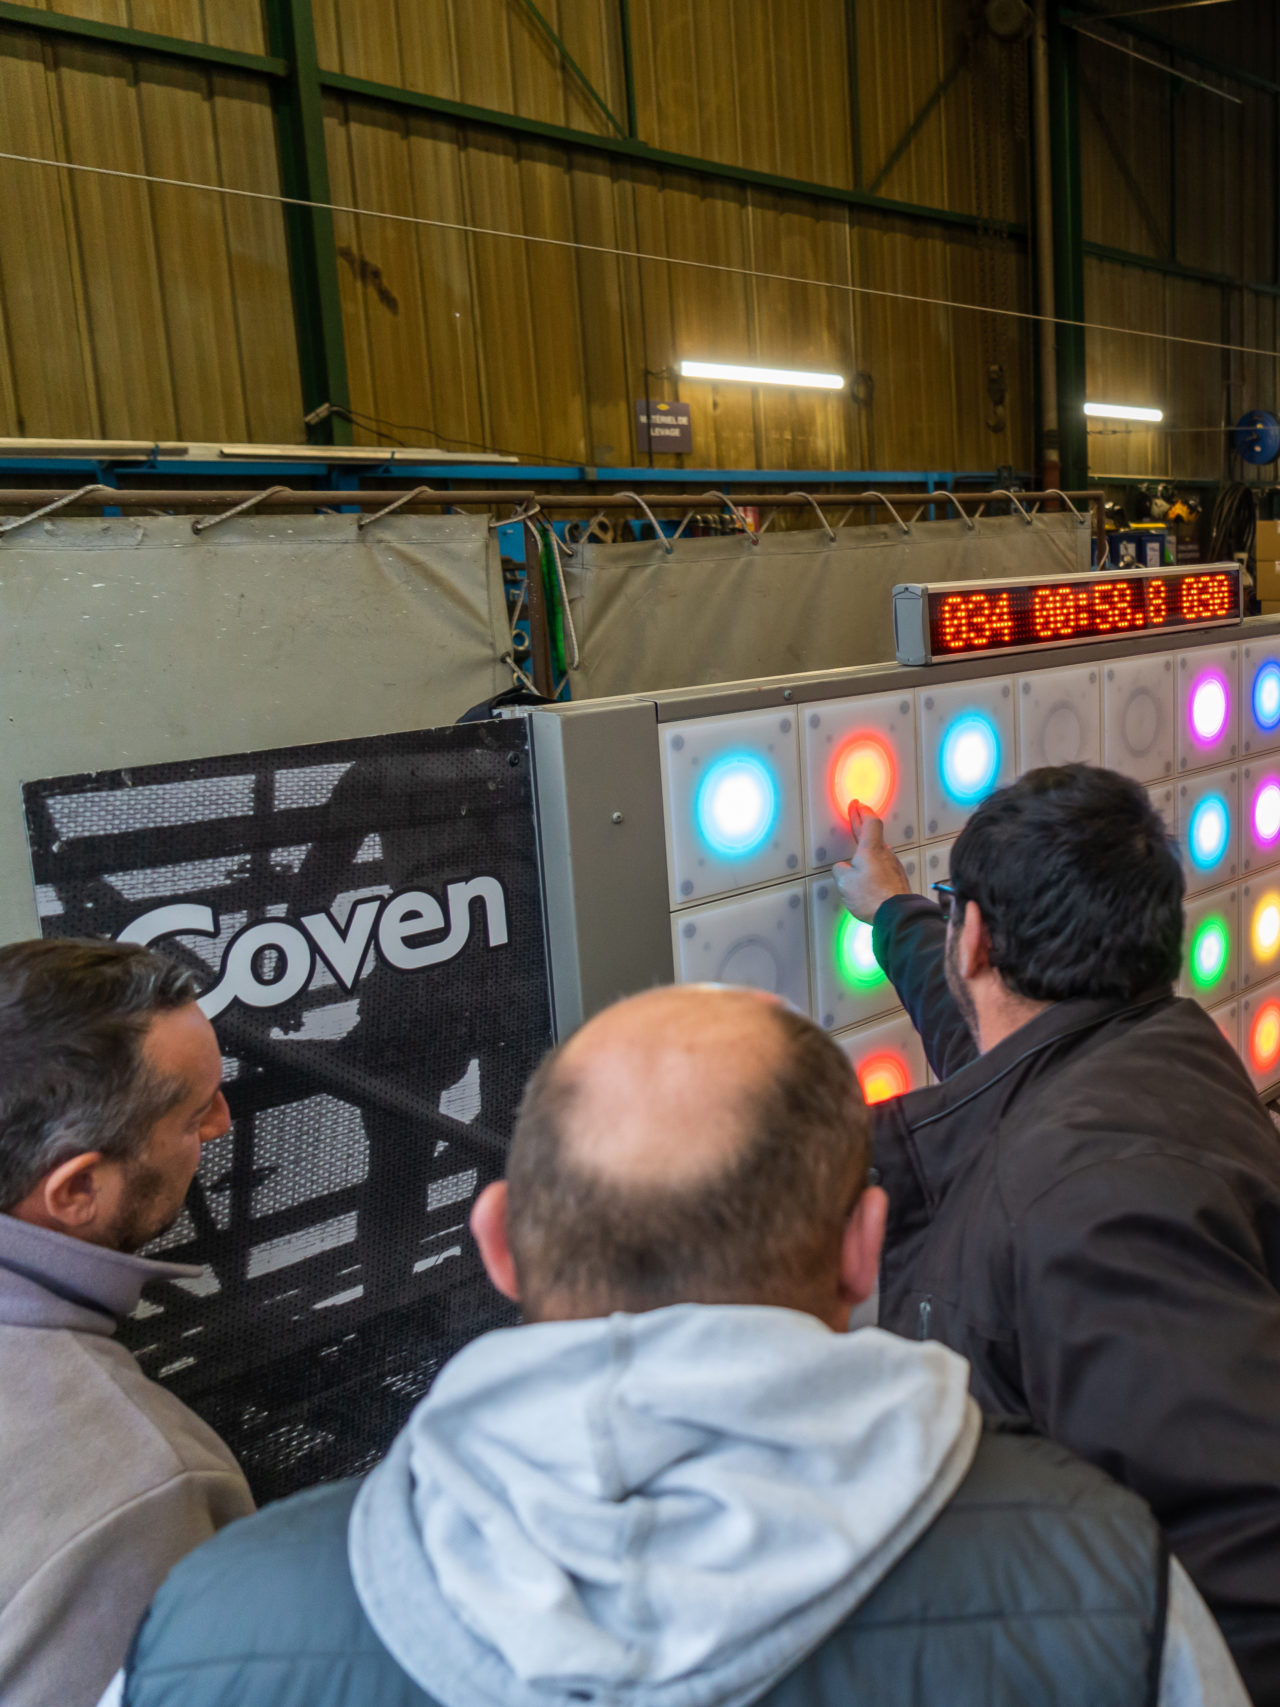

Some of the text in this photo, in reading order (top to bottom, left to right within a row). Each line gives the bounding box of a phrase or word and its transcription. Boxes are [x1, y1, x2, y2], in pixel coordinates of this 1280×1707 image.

[640, 414, 676, 424] MTÉRIEL
[650, 427, 680, 437] LEVAGE
[944, 592, 1012, 646] 034
[115, 875, 509, 1020] Coven
